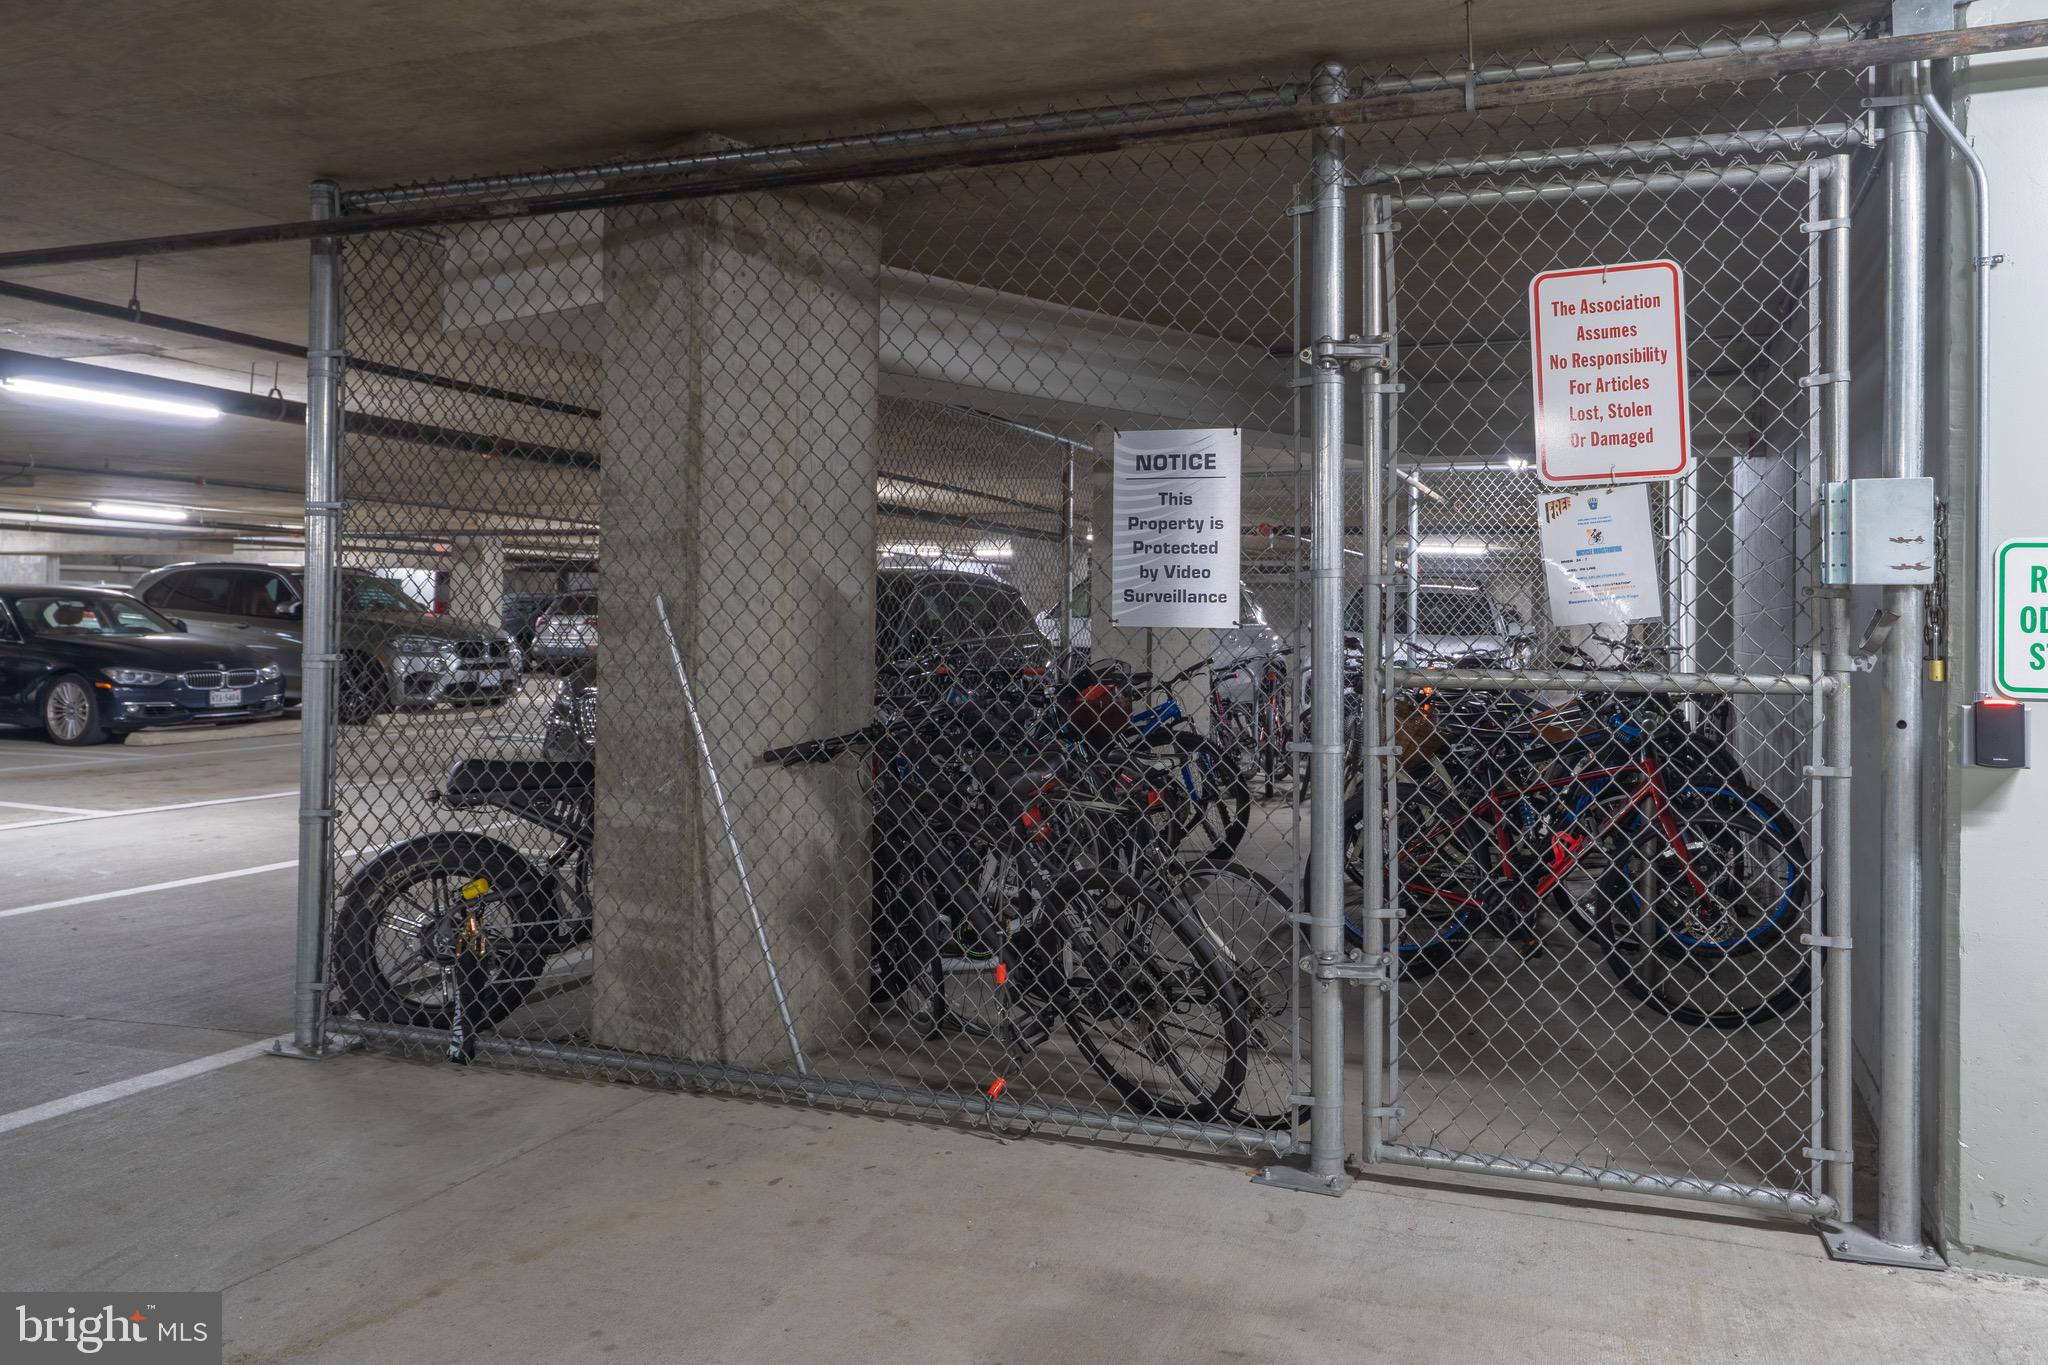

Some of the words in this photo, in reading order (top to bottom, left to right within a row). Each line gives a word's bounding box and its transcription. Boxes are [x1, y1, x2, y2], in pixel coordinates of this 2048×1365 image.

[1552, 301, 1575, 316] The
[1580, 294, 1660, 314] Association
[1577, 325, 1637, 341] Assumes
[1550, 354, 1567, 370] No
[1572, 347, 1667, 370] Responsibility
[1570, 380, 1591, 395] For
[1596, 375, 1650, 393] Articles
[1570, 406, 1603, 423] Lost,
[1608, 402, 1652, 419] Stolen
[1571, 434, 1586, 448] Or
[1591, 428, 1654, 448] Damaged
[1136, 454, 1216, 471] NOTICE
[1159, 492, 1192, 505] This
[1545, 496, 1572, 523] FREE
[1128, 517, 1204, 533] Property
[1210, 516, 1224, 529] is
[1133, 541, 1218, 554] Protected
[1140, 565, 1158, 582] by
[1164, 565, 1210, 579] Video
[1124, 589, 1227, 603] Surveillance
[2030, 643, 2048, 670] S
